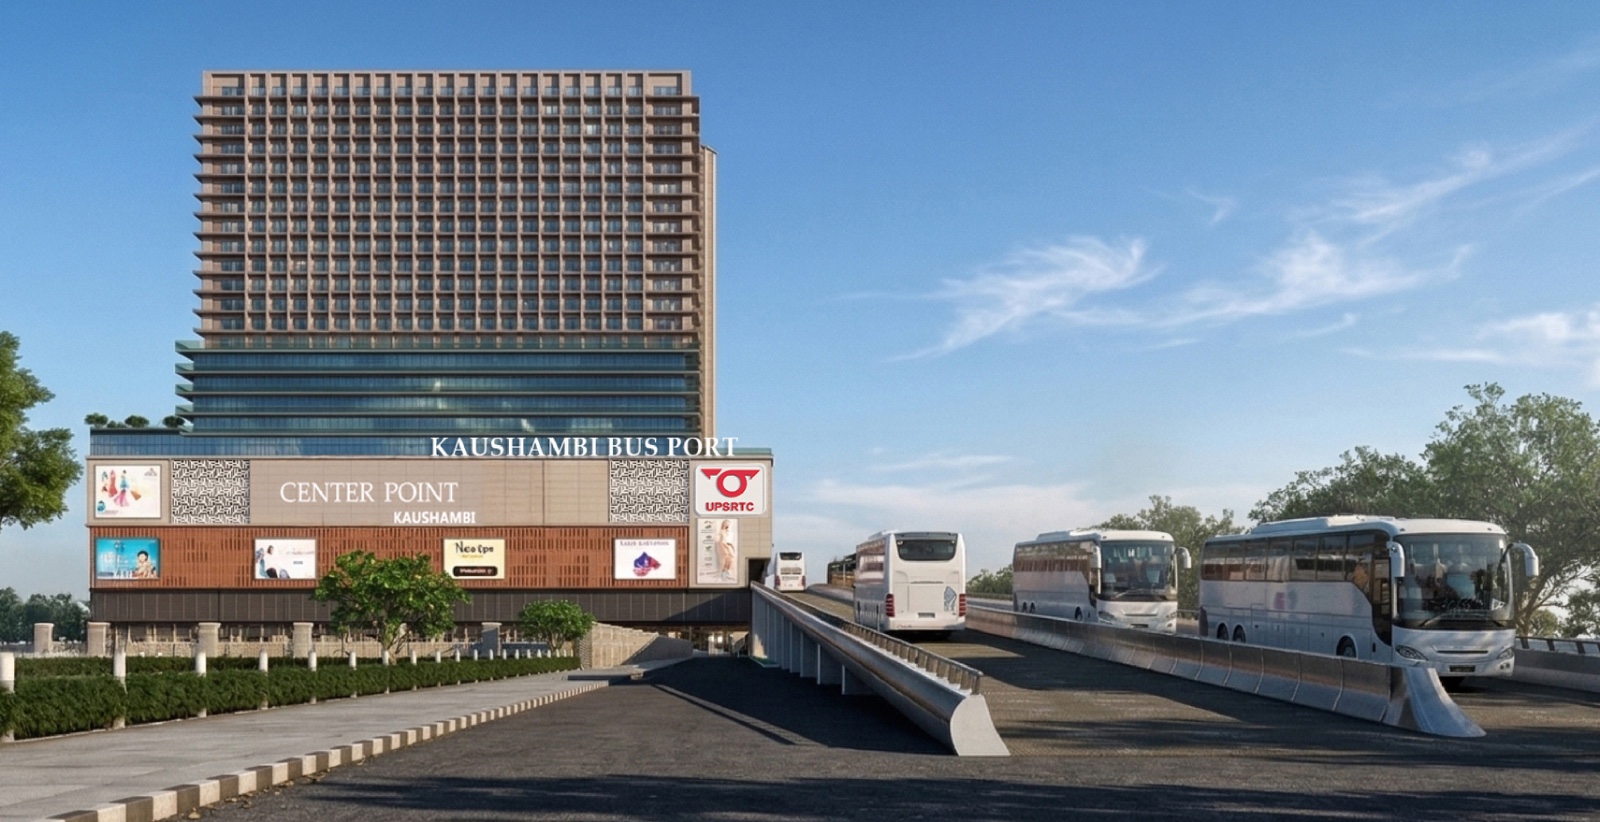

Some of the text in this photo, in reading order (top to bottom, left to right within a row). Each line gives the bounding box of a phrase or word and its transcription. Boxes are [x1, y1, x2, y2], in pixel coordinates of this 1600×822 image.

[430, 437, 739, 457] KAUSHAMBI BUS PORT
[279, 481, 459, 503] CENTER POINT
[705, 502, 755, 512] UPSRTC
[393, 511, 476, 524] KAUSHAMBI
